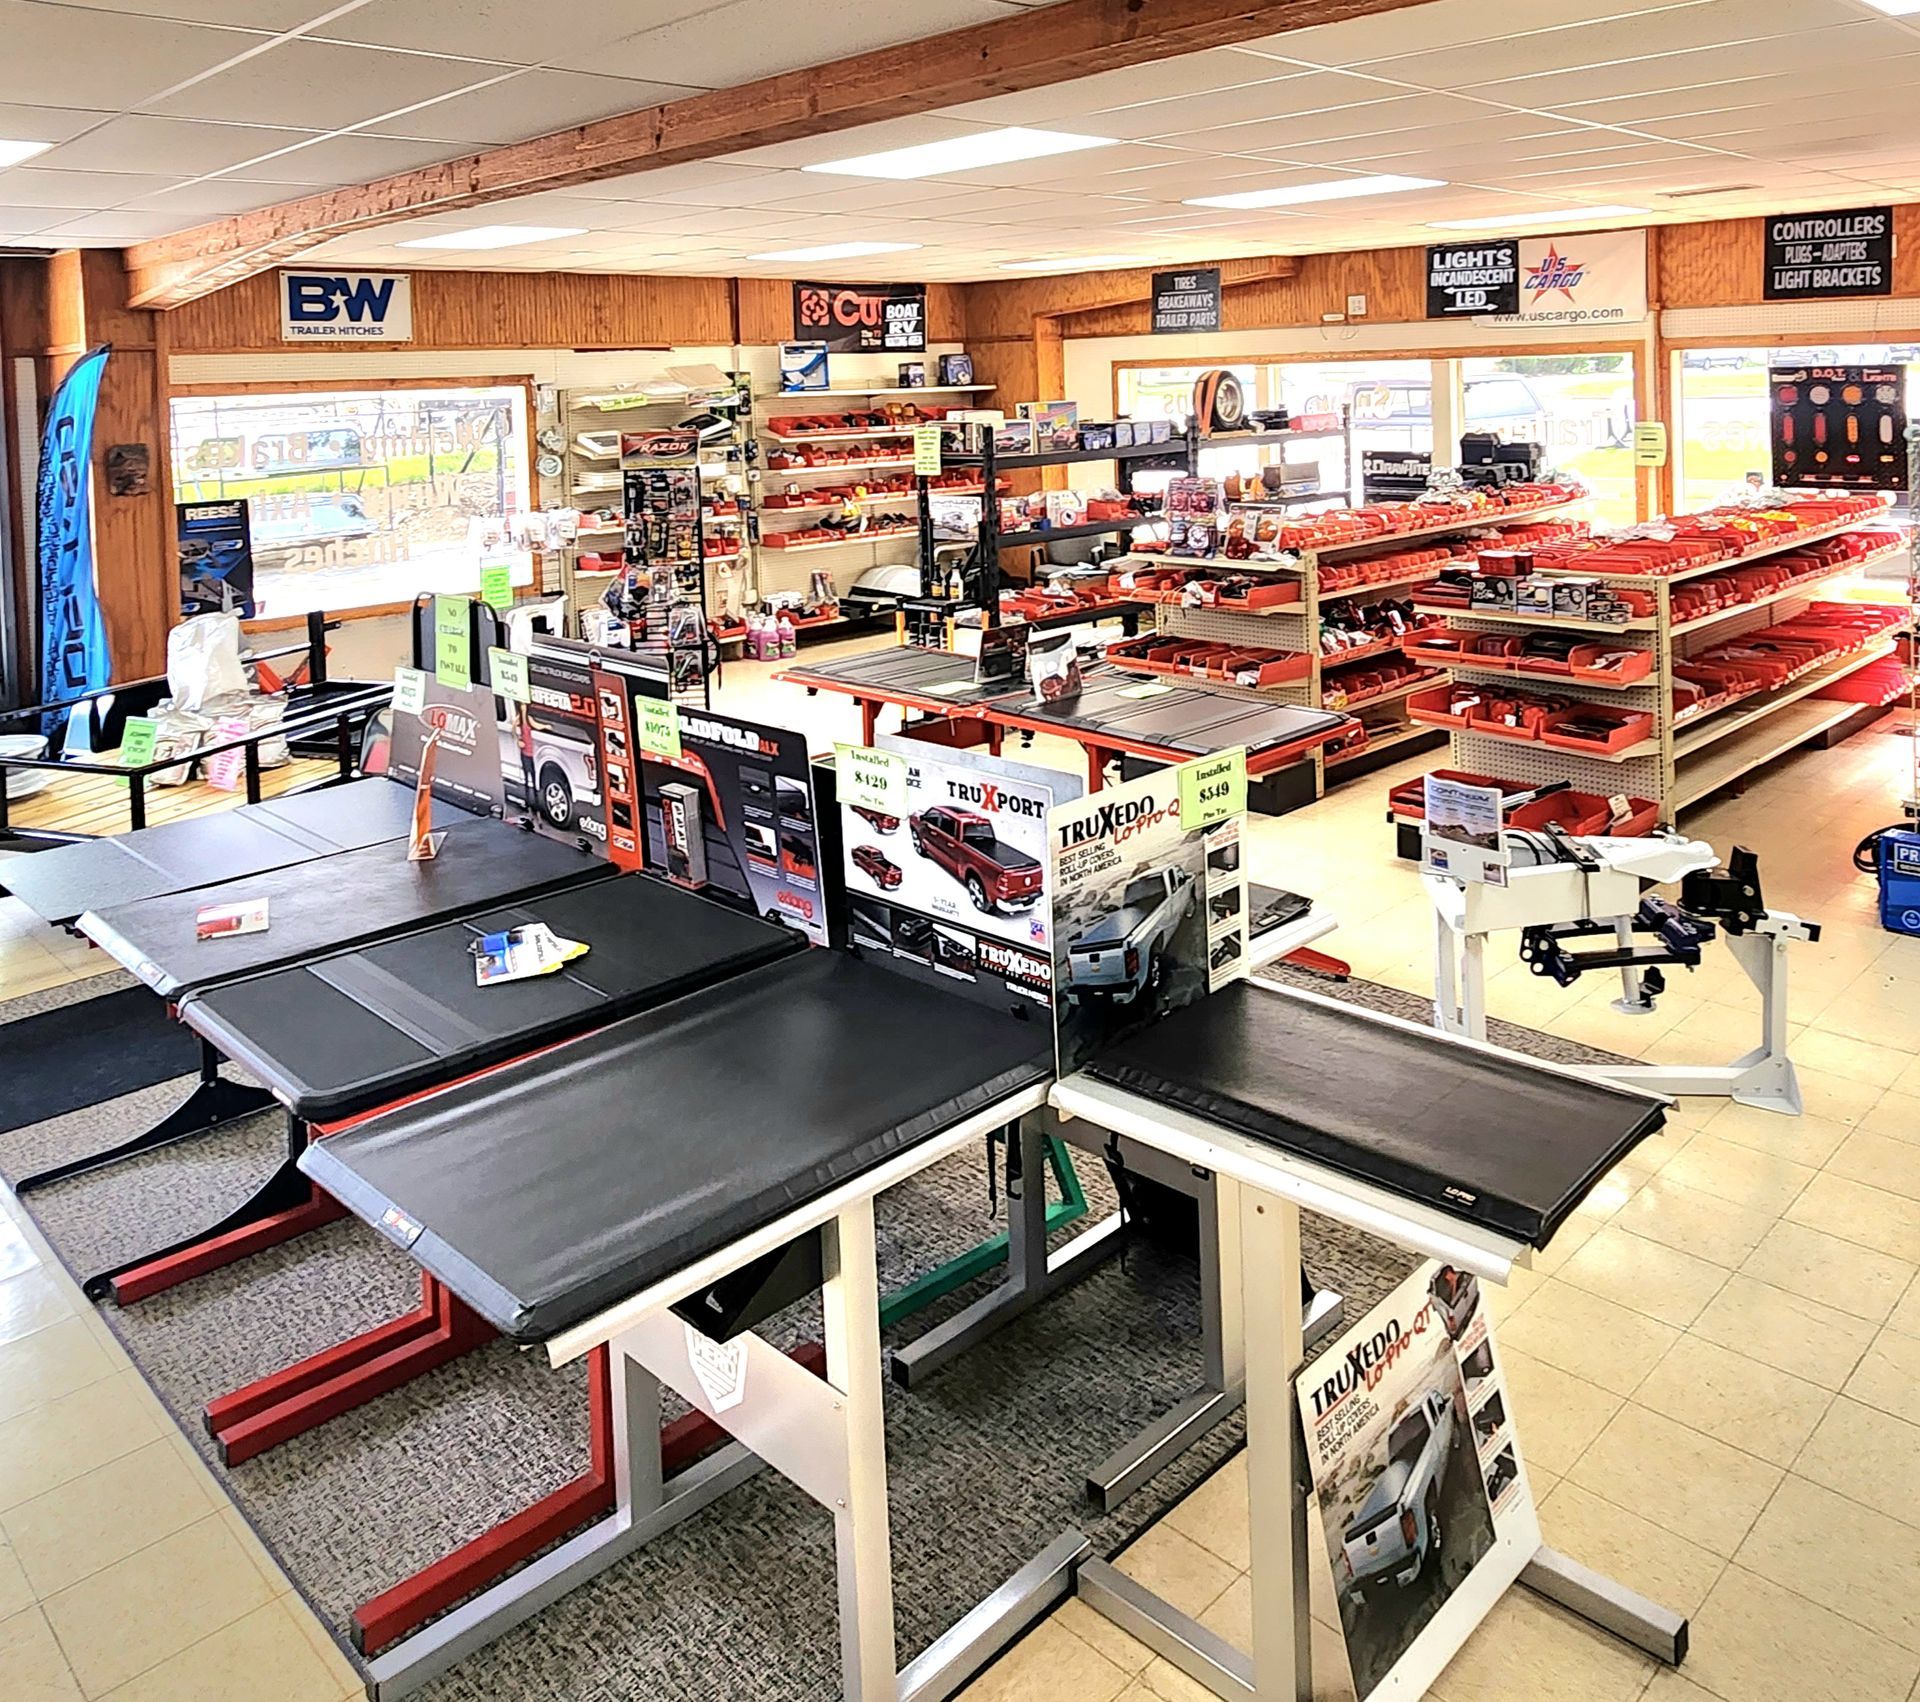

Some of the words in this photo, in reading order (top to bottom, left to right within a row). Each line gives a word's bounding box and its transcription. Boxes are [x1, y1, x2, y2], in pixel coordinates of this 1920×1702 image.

[1772, 214, 1885, 241] CONTROLLERS
[1432, 248, 1513, 270] LIGHTS
[1173, 275, 1197, 290] TIRES
[1430, 267, 1515, 287] INCANDESCENT
[1523, 271, 1584, 290] CARGO
[1773, 269, 1812, 290] LIGHT
[1812, 266, 1882, 288] BRACKETS
[833, 290, 882, 327] CU
[1455, 290, 1487, 307] LED
[885, 302, 920, 320] BOAT
[1155, 313, 1188, 328] TRAILER
[1189, 310, 1217, 326] PARTS
[1493, 306, 1624, 323] www.uscargo.com
[289, 326, 337, 335] TRAILER
[338, 327, 385, 336] HITCHES
[888, 320, 917, 335] RV
[640, 442, 690, 458] RAZOR
[184, 505, 241, 521] REESE
[430, 709, 480, 741] LOMAX
[680, 715, 760, 752] LIDFOLD
[850, 749, 890, 768] Installed
[1196, 760, 1232, 781] Installed
[946, 780, 1044, 819] TRUXPORT
[1199, 780, 1230, 804] $549
[1167, 798, 1181, 817] Q
[1058, 795, 1155, 848] TRUXEDO
[1059, 852, 1076, 867] BEST
[1078, 842, 1106, 860] SELLING
[1059, 859, 1088, 877] ROLL-UP
[1089, 849, 1115, 865] COVERS
[1899, 847, 1919, 862] PR
[1059, 876, 1068, 887] IN
[1069, 867, 1093, 882] NORTH
[1093, 855, 1122, 873] AMERICA
[978, 943, 1052, 981] TRUXEDO
[1310, 1318, 1401, 1418] TRUXEDO
[1316, 1418, 1335, 1442] BEST
[1334, 1393, 1361, 1422] SELLING
[1318, 1420, 1347, 1455] ROLL-UP
[1346, 1397, 1371, 1427] COVERS
[1321, 1453, 1330, 1467] IN
[1330, 1432, 1353, 1458] NORTH
[1353, 1404, 1381, 1435] AMERICA
